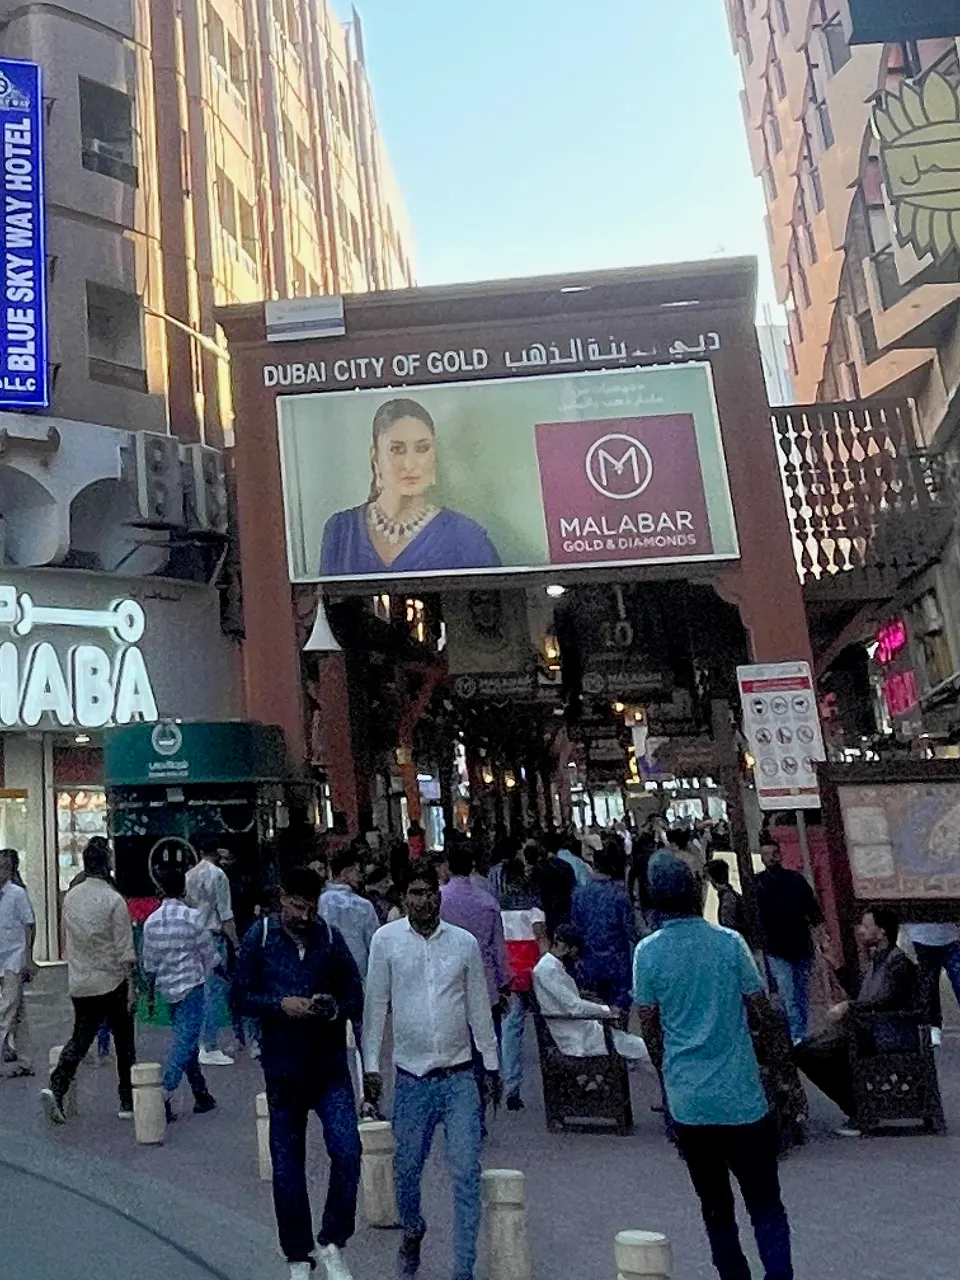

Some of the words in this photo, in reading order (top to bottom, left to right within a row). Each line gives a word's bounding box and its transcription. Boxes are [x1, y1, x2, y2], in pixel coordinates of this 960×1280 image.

[4, 117, 32, 192] HOTEL
[5, 196, 33, 250] WAY
[6, 259, 35, 302] SKY
[6, 308, 36, 372] BLUE
[504, 337, 585, 371] الذهب
[669, 331, 721, 358] دبي
[263, 361, 327, 388] DUBAI
[334, 356, 385, 382] CITY
[392, 351, 422, 377] OF
[427, 347, 489, 374] GOLD
[559, 510, 694, 538] MALABAR
[562, 539, 603, 553] GOLD
[605, 538, 616, 551] &
[618, 533, 697, 550] DIAMONDS
